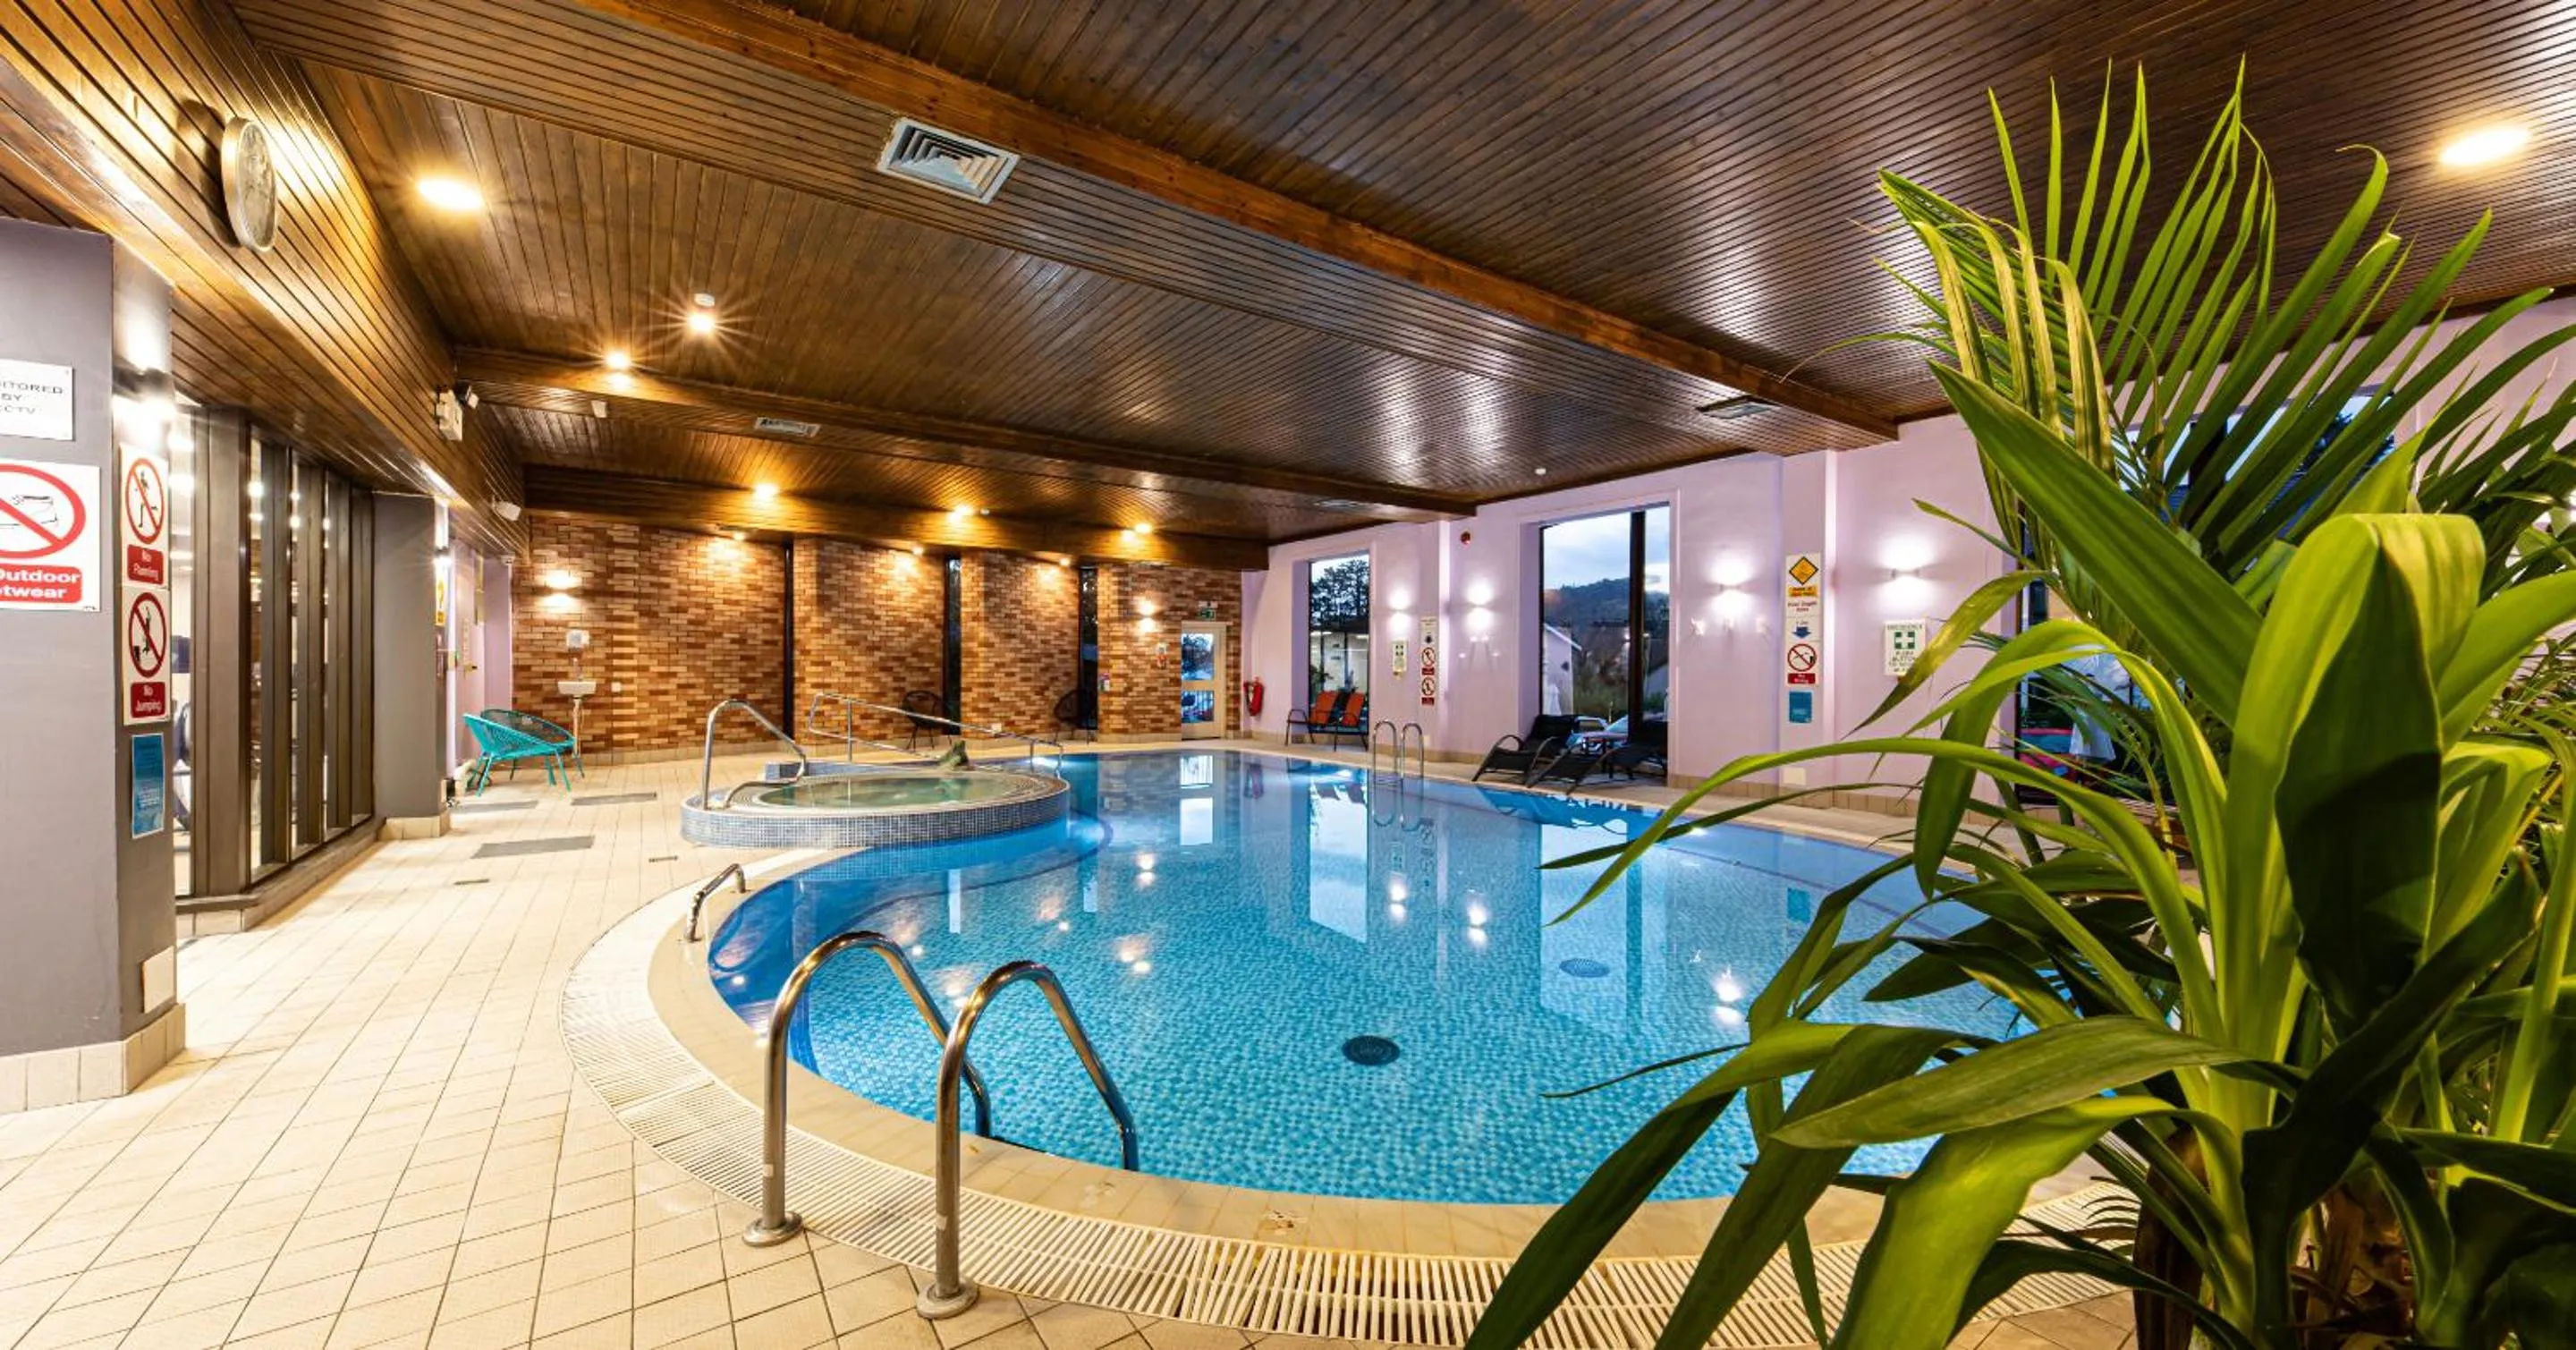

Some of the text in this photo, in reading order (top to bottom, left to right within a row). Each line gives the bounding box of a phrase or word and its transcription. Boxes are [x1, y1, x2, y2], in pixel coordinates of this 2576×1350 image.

[0, 380, 64, 395] ITORED
[2, 393, 22, 402] BY
[0, 404, 36, 415] CTV
[0, 584, 68, 599] twear
